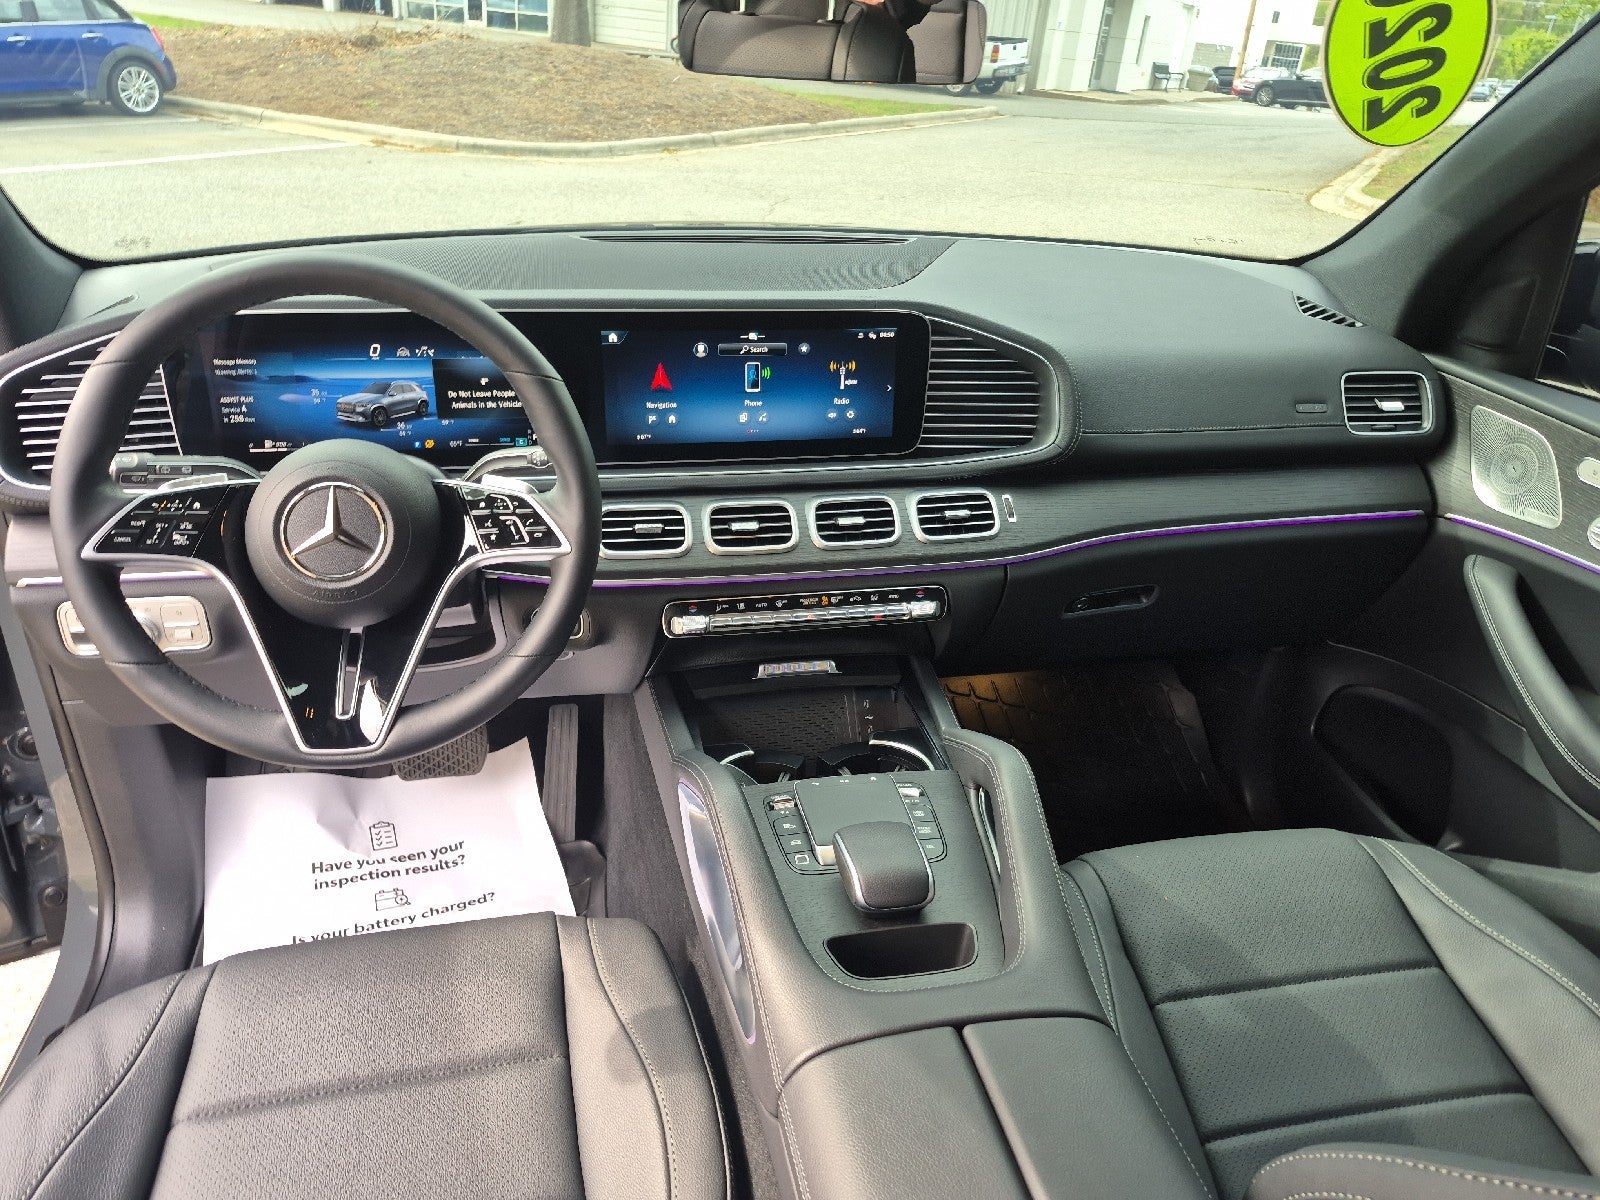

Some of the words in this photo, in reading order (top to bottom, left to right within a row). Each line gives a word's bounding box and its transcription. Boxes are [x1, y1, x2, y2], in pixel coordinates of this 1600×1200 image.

[749, 345, 769, 354] Search
[447, 390, 458, 399] Do
[458, 390, 472, 398] Not
[473, 390, 492, 398] Leave
[451, 400, 477, 409] Animals
[478, 400, 486, 409] in
[487, 400, 497, 409] the
[498, 399, 523, 408] Vehicle
[646, 400, 678, 410] Navigation
[744, 399, 763, 408] Phone
[833, 397, 850, 406] Radio
[311, 858, 353, 875] Have
[356, 858, 386, 870] you
[389, 850, 427, 864] seen
[430, 840, 465, 860] your
[314, 868, 401, 890] inspection
[405, 854, 465, 877] results?
[354, 914, 417, 934] battery
[421, 892, 496, 919] charged?
